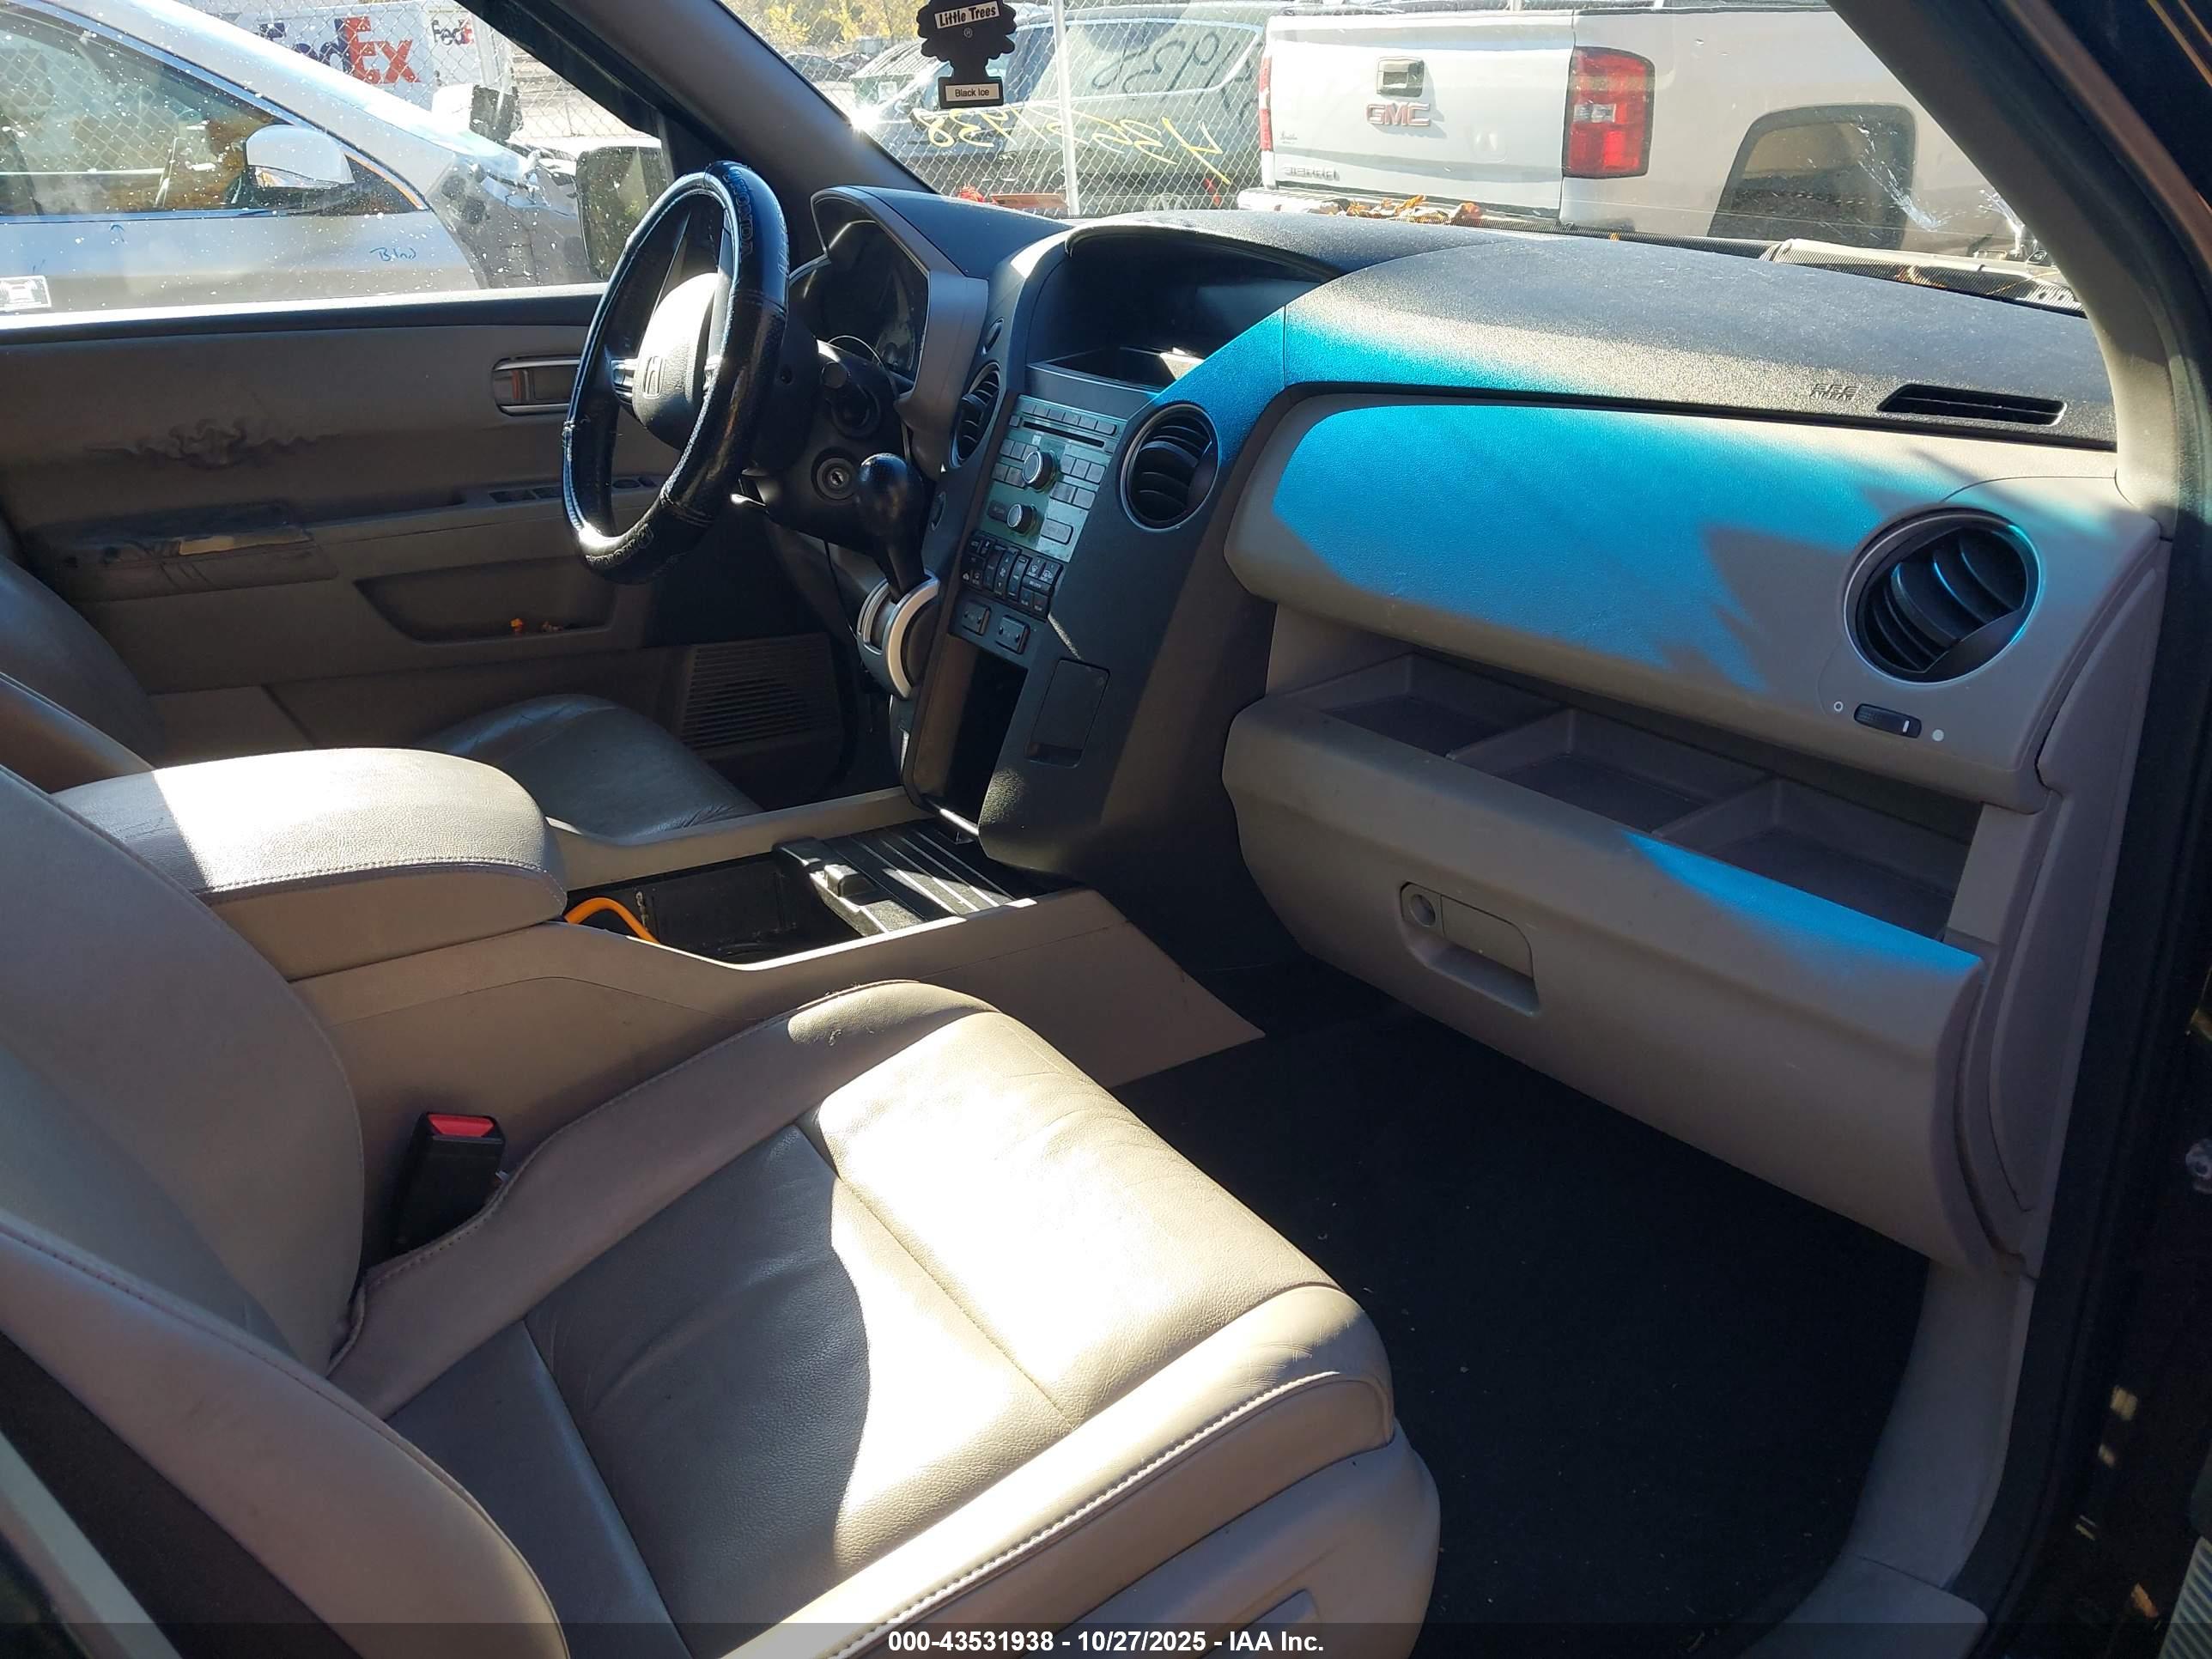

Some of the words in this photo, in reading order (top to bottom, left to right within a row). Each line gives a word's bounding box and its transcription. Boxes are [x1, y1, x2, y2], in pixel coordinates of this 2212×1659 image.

[939, 10, 966, 27] Little
[969, 6, 996, 21] Trees
[955, 88, 976, 97] Black
[1367, 102, 1431, 126] GMC
